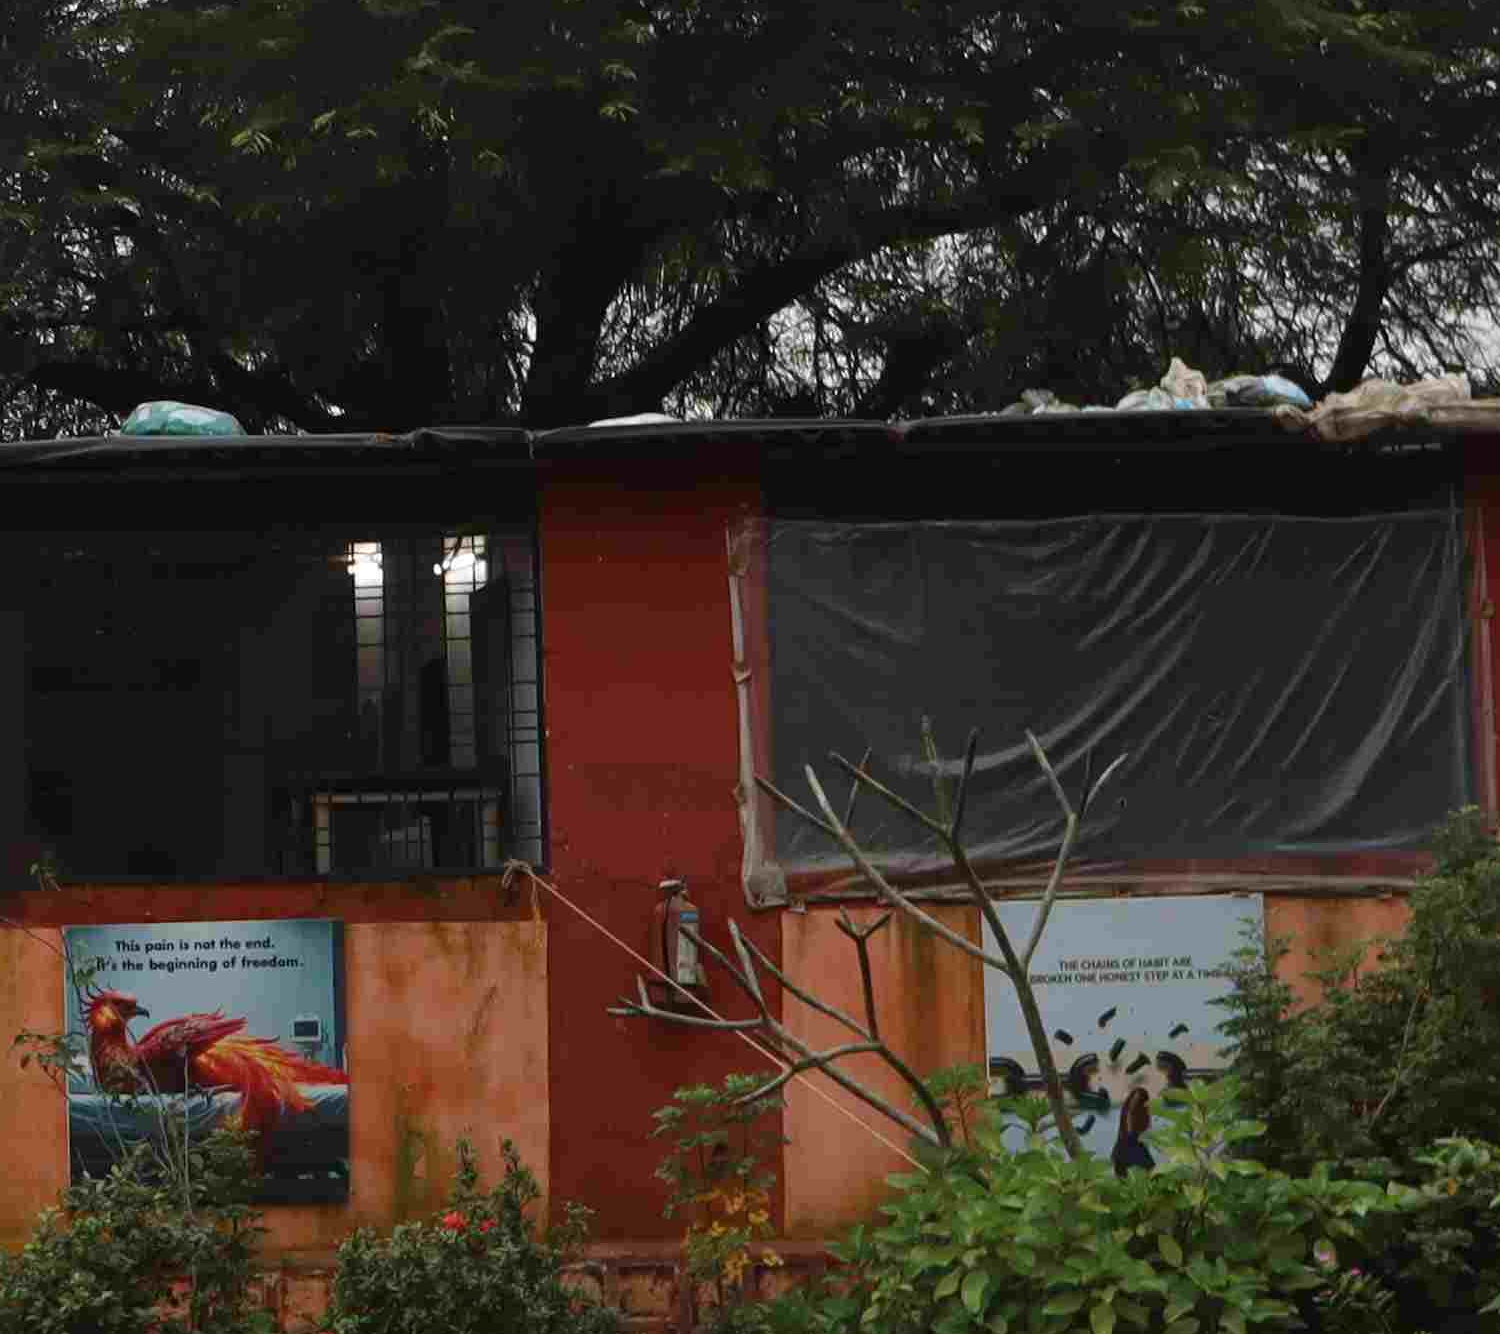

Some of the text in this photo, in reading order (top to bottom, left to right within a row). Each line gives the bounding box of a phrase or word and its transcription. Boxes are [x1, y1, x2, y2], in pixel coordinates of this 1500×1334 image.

[116, 936, 275, 954] This pain is not the end.
[122, 959, 143, 971] the
[149, 957, 217, 972] beginning
[222, 956, 236, 969] of
[241, 955, 304, 968] freedom.
[1059, 955, 1193, 971] THE CHAINS OF HABIT ARE
[1099, 971, 1141, 982] HONEST
[1144, 971, 1169, 981] STEP
